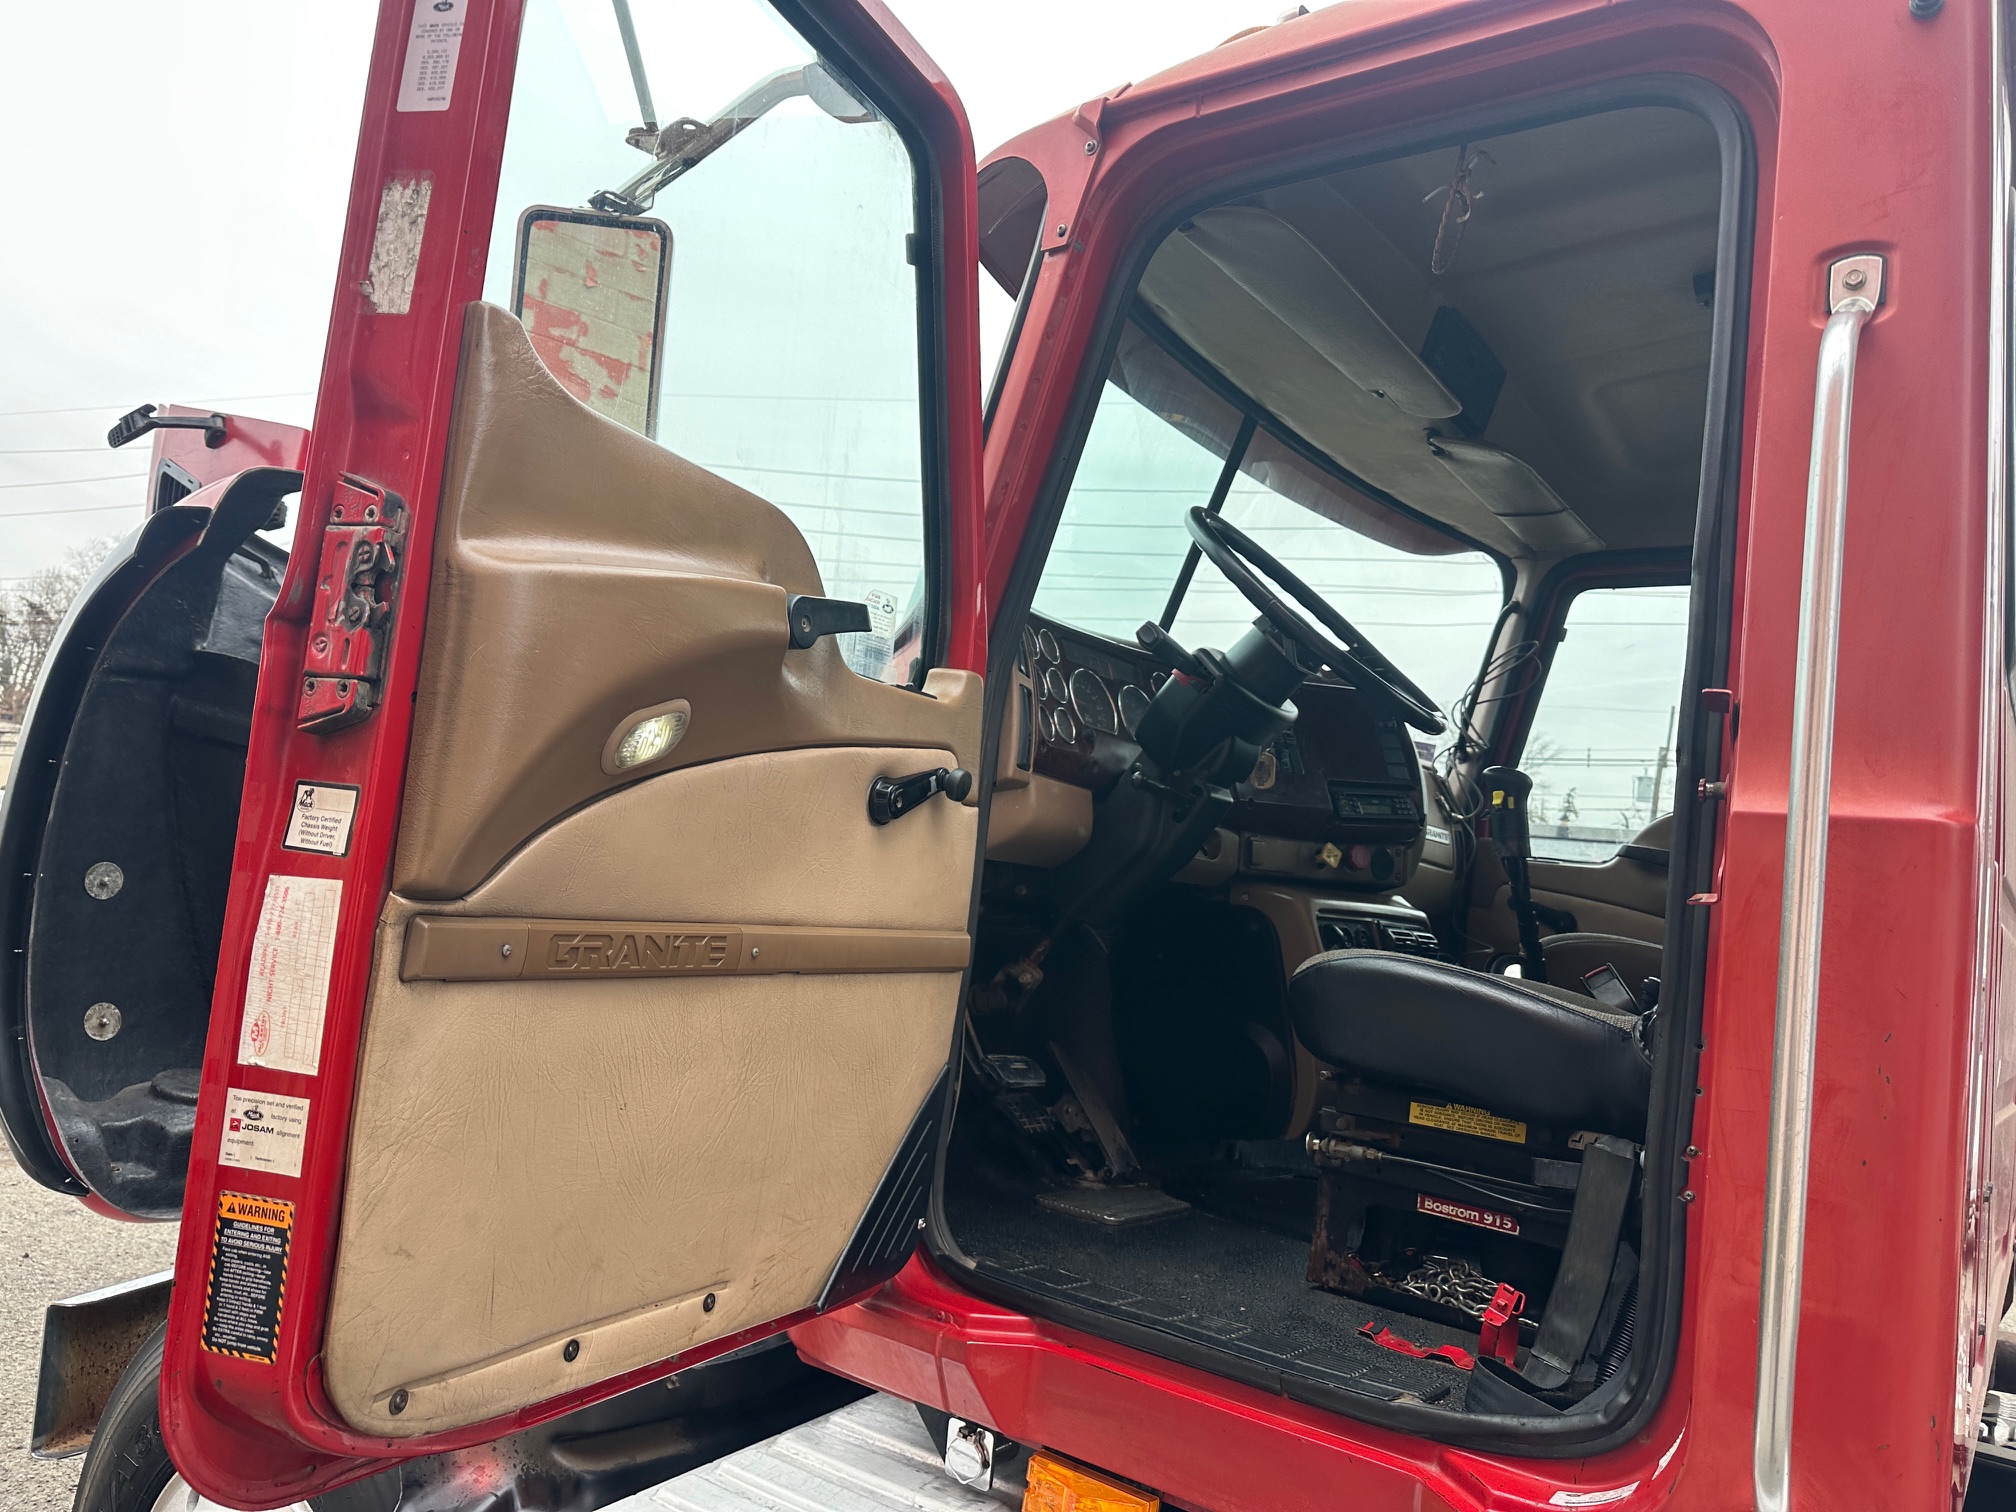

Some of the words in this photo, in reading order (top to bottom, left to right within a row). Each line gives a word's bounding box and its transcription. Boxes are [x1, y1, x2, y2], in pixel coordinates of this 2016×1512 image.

[321, 824, 338, 833] Weight
[259, 943, 270, 976] READING
[546, 934, 728, 970] GRANITE
[269, 948, 279, 976] SERVICE
[266, 979, 275, 1002] NIGHT
[243, 1097, 266, 1105] precision
[1454, 1103, 1490, 1116] WARNING
[270, 1114, 288, 1122] factory
[242, 1123, 274, 1134] JOSAM
[276, 1130, 300, 1140] alignment
[238, 1202, 285, 1223] WARNING
[1425, 1198, 1479, 1221] Bostrom
[1483, 1211, 1512, 1229] 915
[233, 1221, 264, 1231] GUIDELINES
[224, 1228, 250, 1238] ENTERING
[262, 1235, 281, 1244] EXITING
[244, 1241, 265, 1250] SERIOUS
